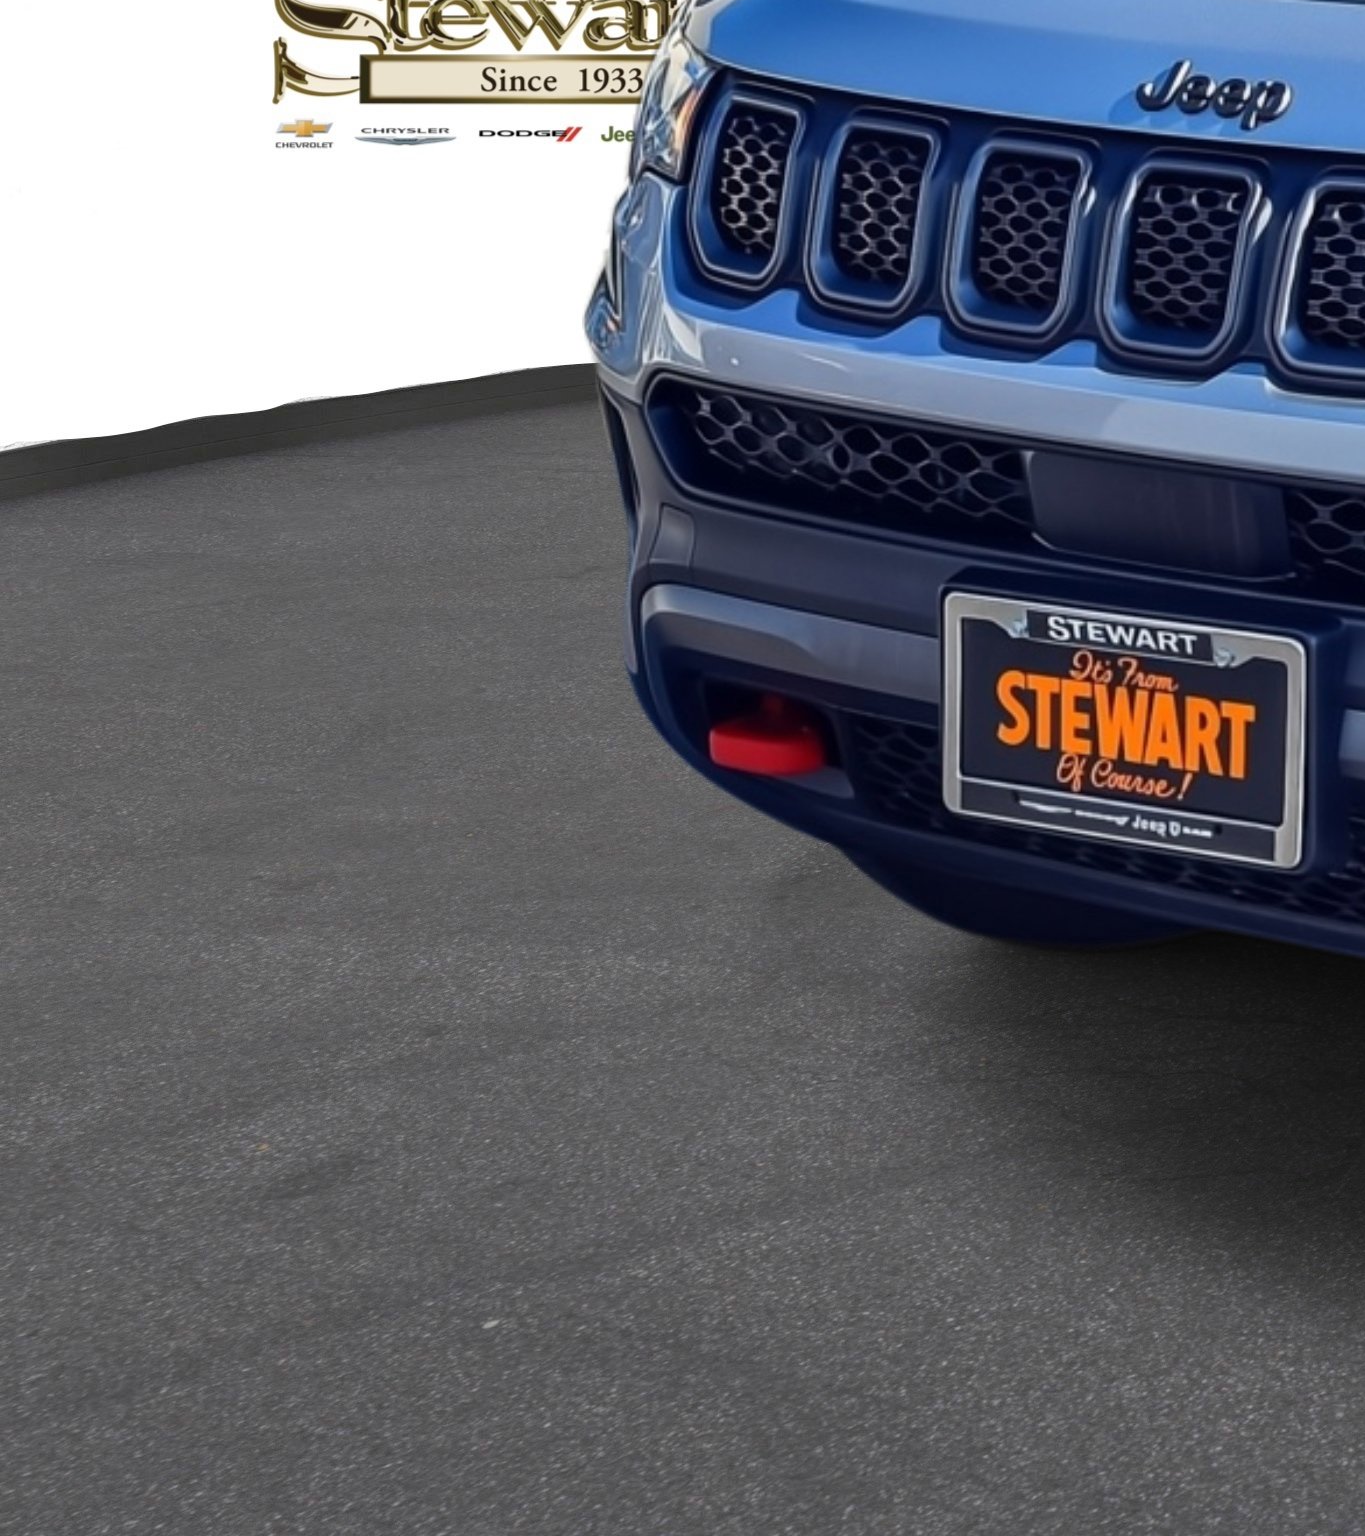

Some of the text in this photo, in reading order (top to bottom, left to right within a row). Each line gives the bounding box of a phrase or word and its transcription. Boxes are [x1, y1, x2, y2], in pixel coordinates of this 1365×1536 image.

[480, 66, 644, 94] Since 1933
[1136, 59, 1292, 131] Jeep
[478, 129, 567, 137] DODGE
[600, 125, 636, 142] Jee
[1047, 615, 1198, 655] STEWART
[1069, 649, 1179, 692] It's From
[996, 670, 1256, 779] STEWART
[1056, 752, 1088, 794] Of
